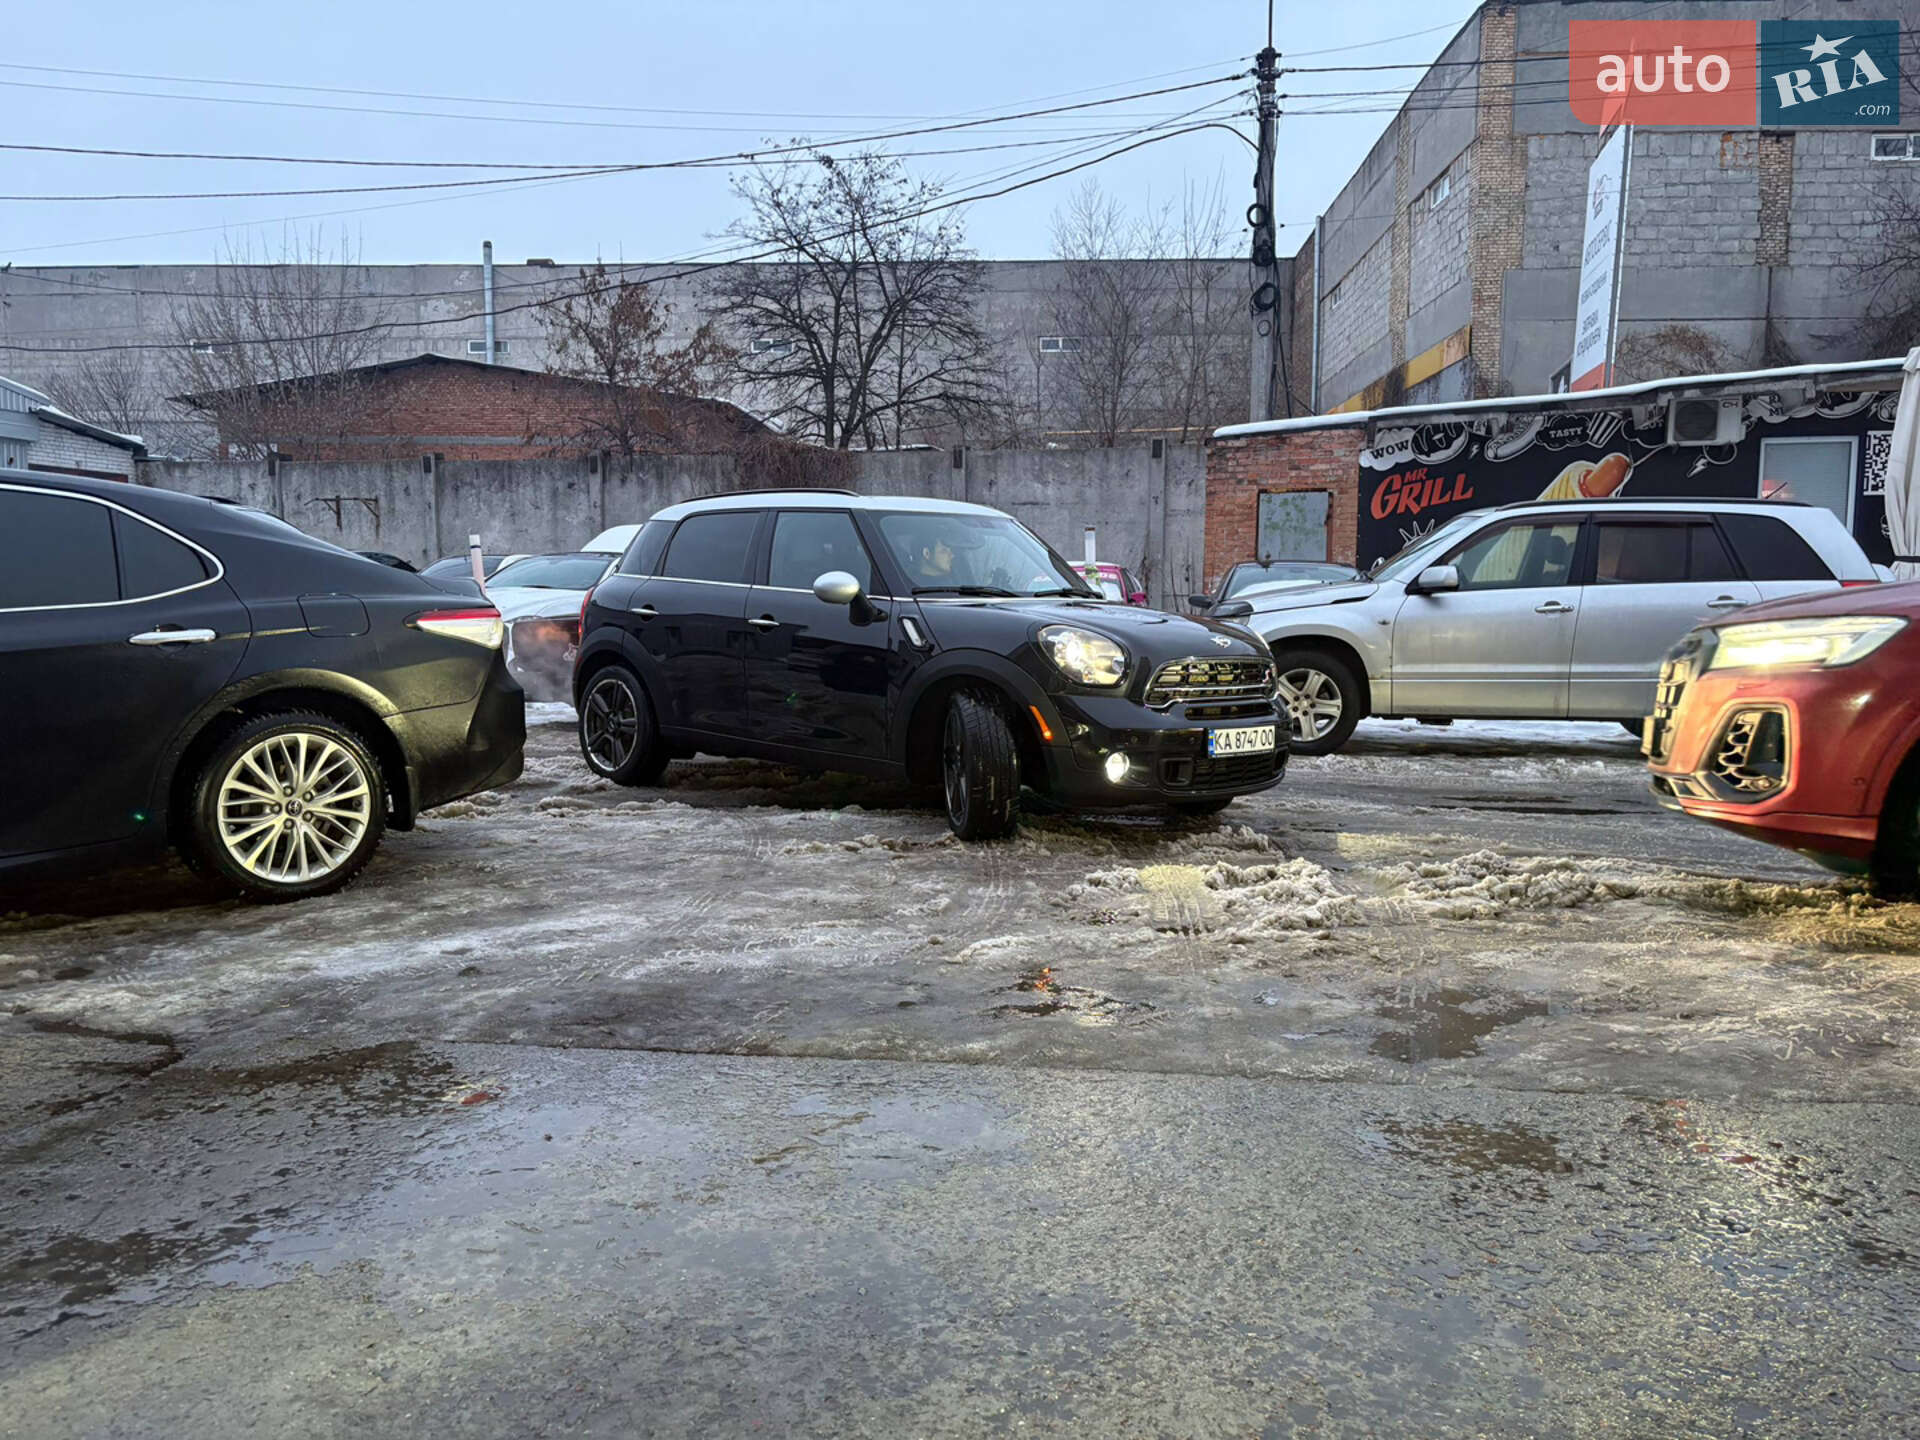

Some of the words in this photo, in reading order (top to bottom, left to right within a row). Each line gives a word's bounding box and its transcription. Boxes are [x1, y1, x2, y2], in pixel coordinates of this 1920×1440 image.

[1548, 426, 1583, 439] TASTY
[1370, 439, 1409, 460] WOW
[1404, 467, 1428, 482] MR
[1370, 473, 1475, 520] GRILL
[1215, 732, 1232, 750] KA
[1235, 730, 1259, 749] 8747
